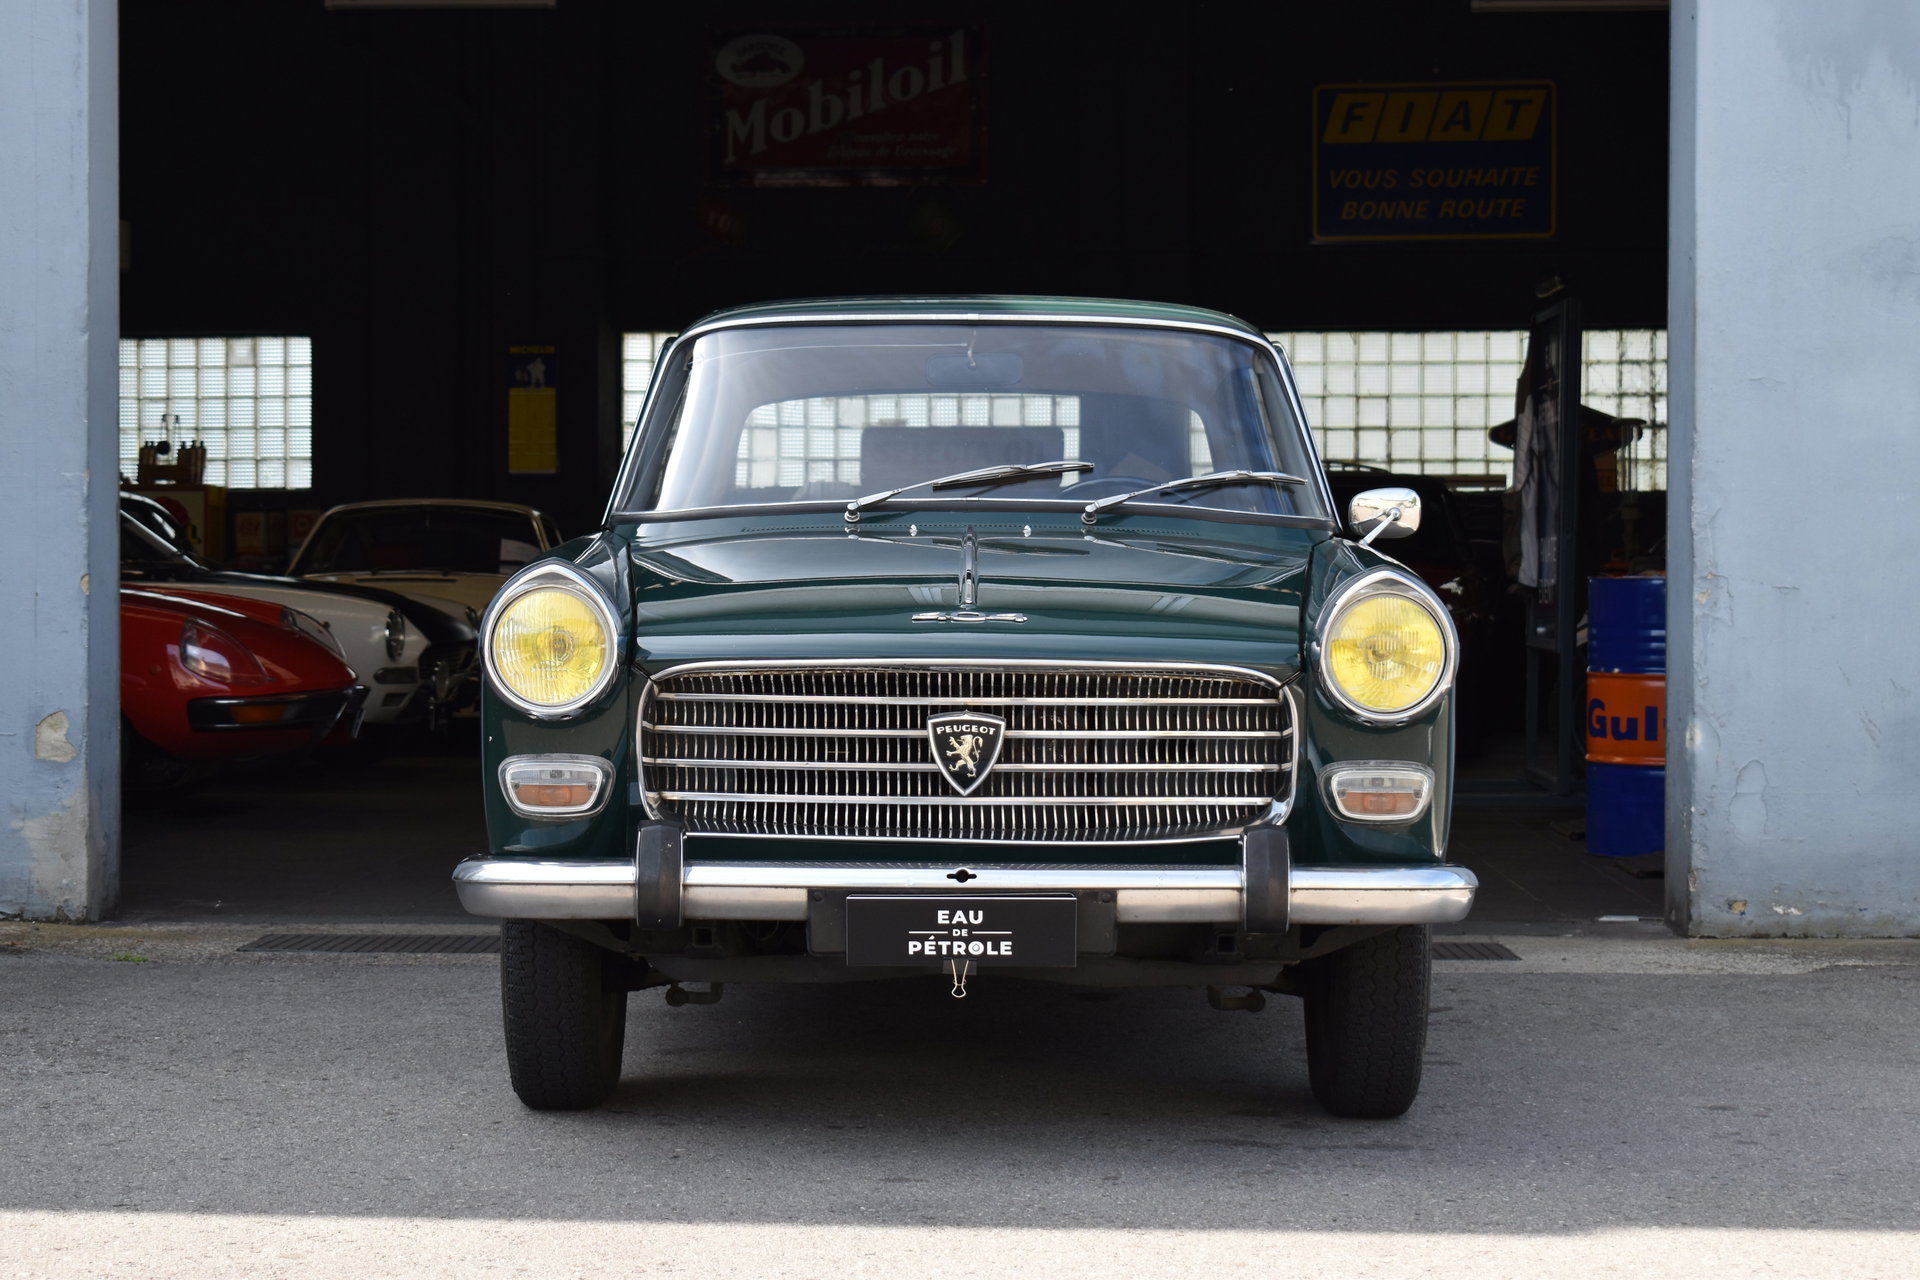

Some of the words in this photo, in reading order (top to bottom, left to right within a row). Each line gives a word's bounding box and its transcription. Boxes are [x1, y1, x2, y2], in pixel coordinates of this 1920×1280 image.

[723, 28, 968, 166] Mobiloil
[1339, 98, 1534, 135] FIAT
[1329, 168, 1400, 190] VOUS
[1408, 166, 1541, 189] SOUHAITE
[1340, 199, 1430, 221] BONNE
[1439, 198, 1528, 219] ROUTE
[935, 724, 997, 736] PEUGEOT
[1587, 698, 1666, 742] Gul
[937, 909, 984, 925] EAU
[952, 928, 969, 937] DE
[908, 935, 1013, 956] PÉTROLE
